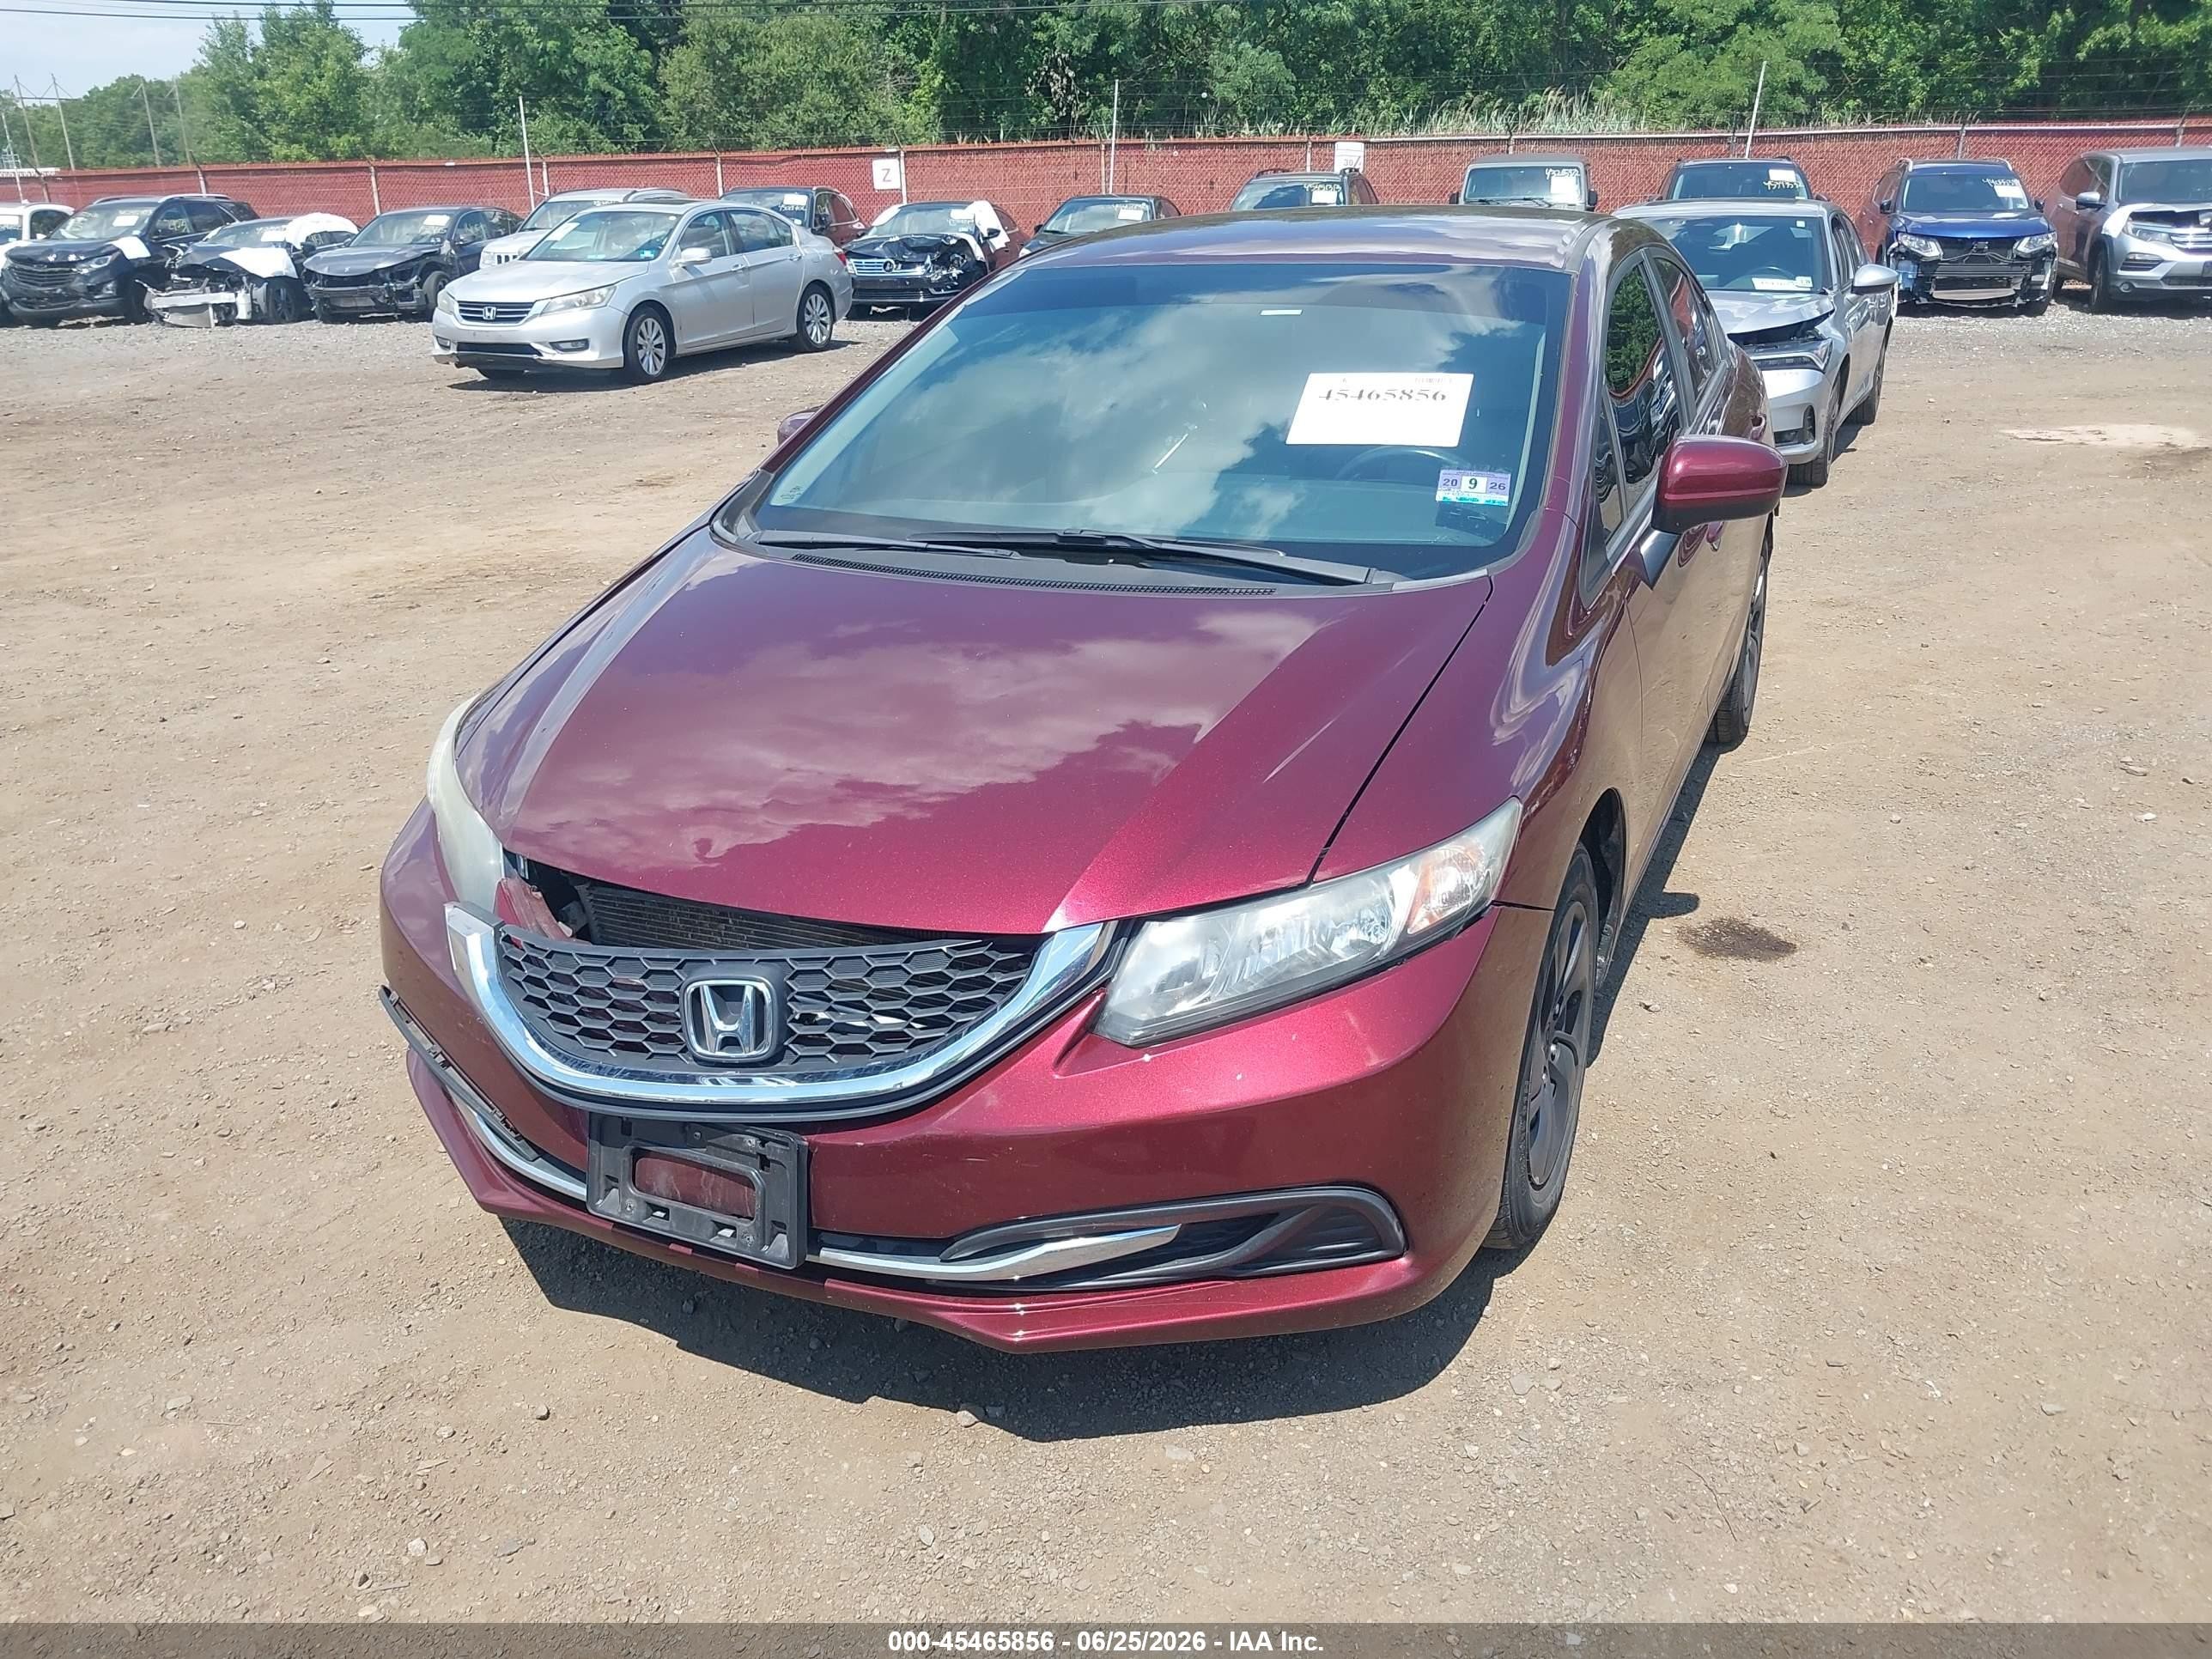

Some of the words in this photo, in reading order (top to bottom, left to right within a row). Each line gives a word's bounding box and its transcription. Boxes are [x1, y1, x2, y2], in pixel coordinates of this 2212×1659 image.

[881, 168, 892, 182] Z
[1319, 389, 1446, 401] 45465856
[1443, 478, 1458, 487] 20
[1468, 477, 1478, 489] 9
[1489, 482, 1506, 490] 26
